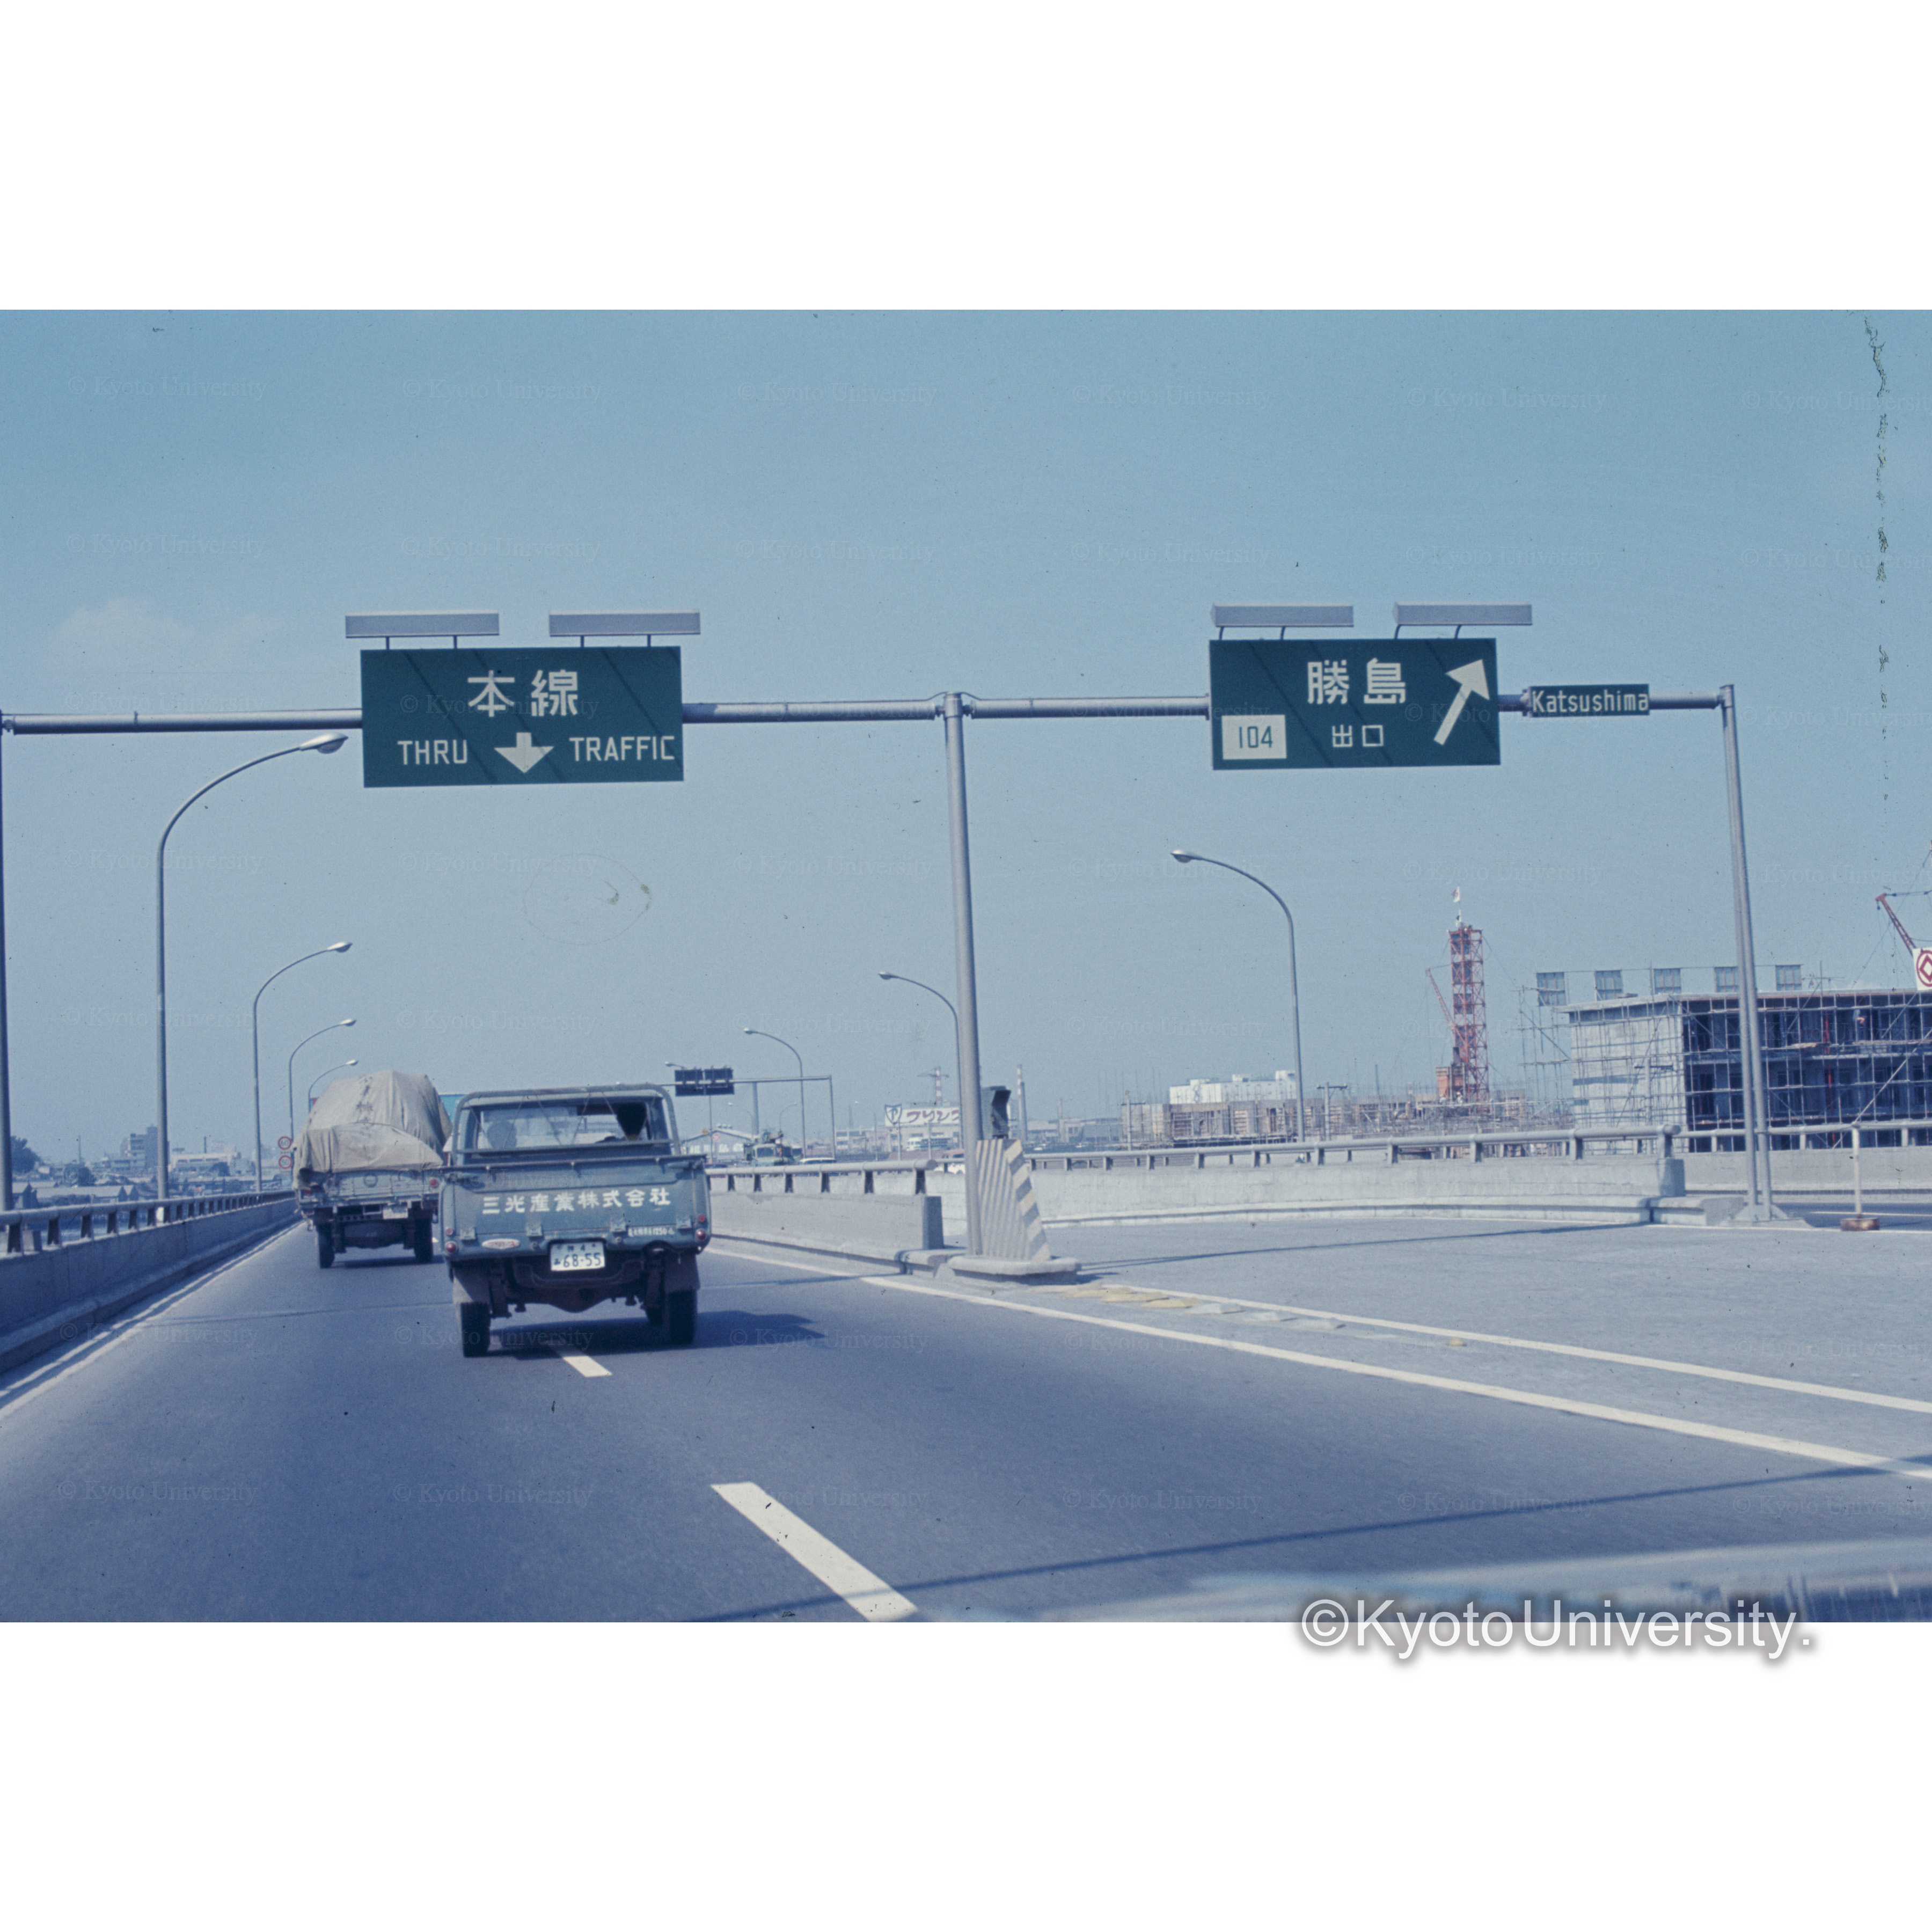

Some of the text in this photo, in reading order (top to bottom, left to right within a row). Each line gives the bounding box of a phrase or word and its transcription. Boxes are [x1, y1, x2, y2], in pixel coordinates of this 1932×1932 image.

[468, 670, 577, 717] 本線
[1307, 658, 1406, 705] 勝島
[1532, 689, 1649, 712] Katsushima
[1239, 726, 1273, 749] 104
[1332, 724, 1384, 748] 出口
[398, 736, 675, 765] THRU TRAFFIC
[482, 1187, 671, 1214] 三光産業株式会社
[563, 1253, 601, 1268] 68-55
